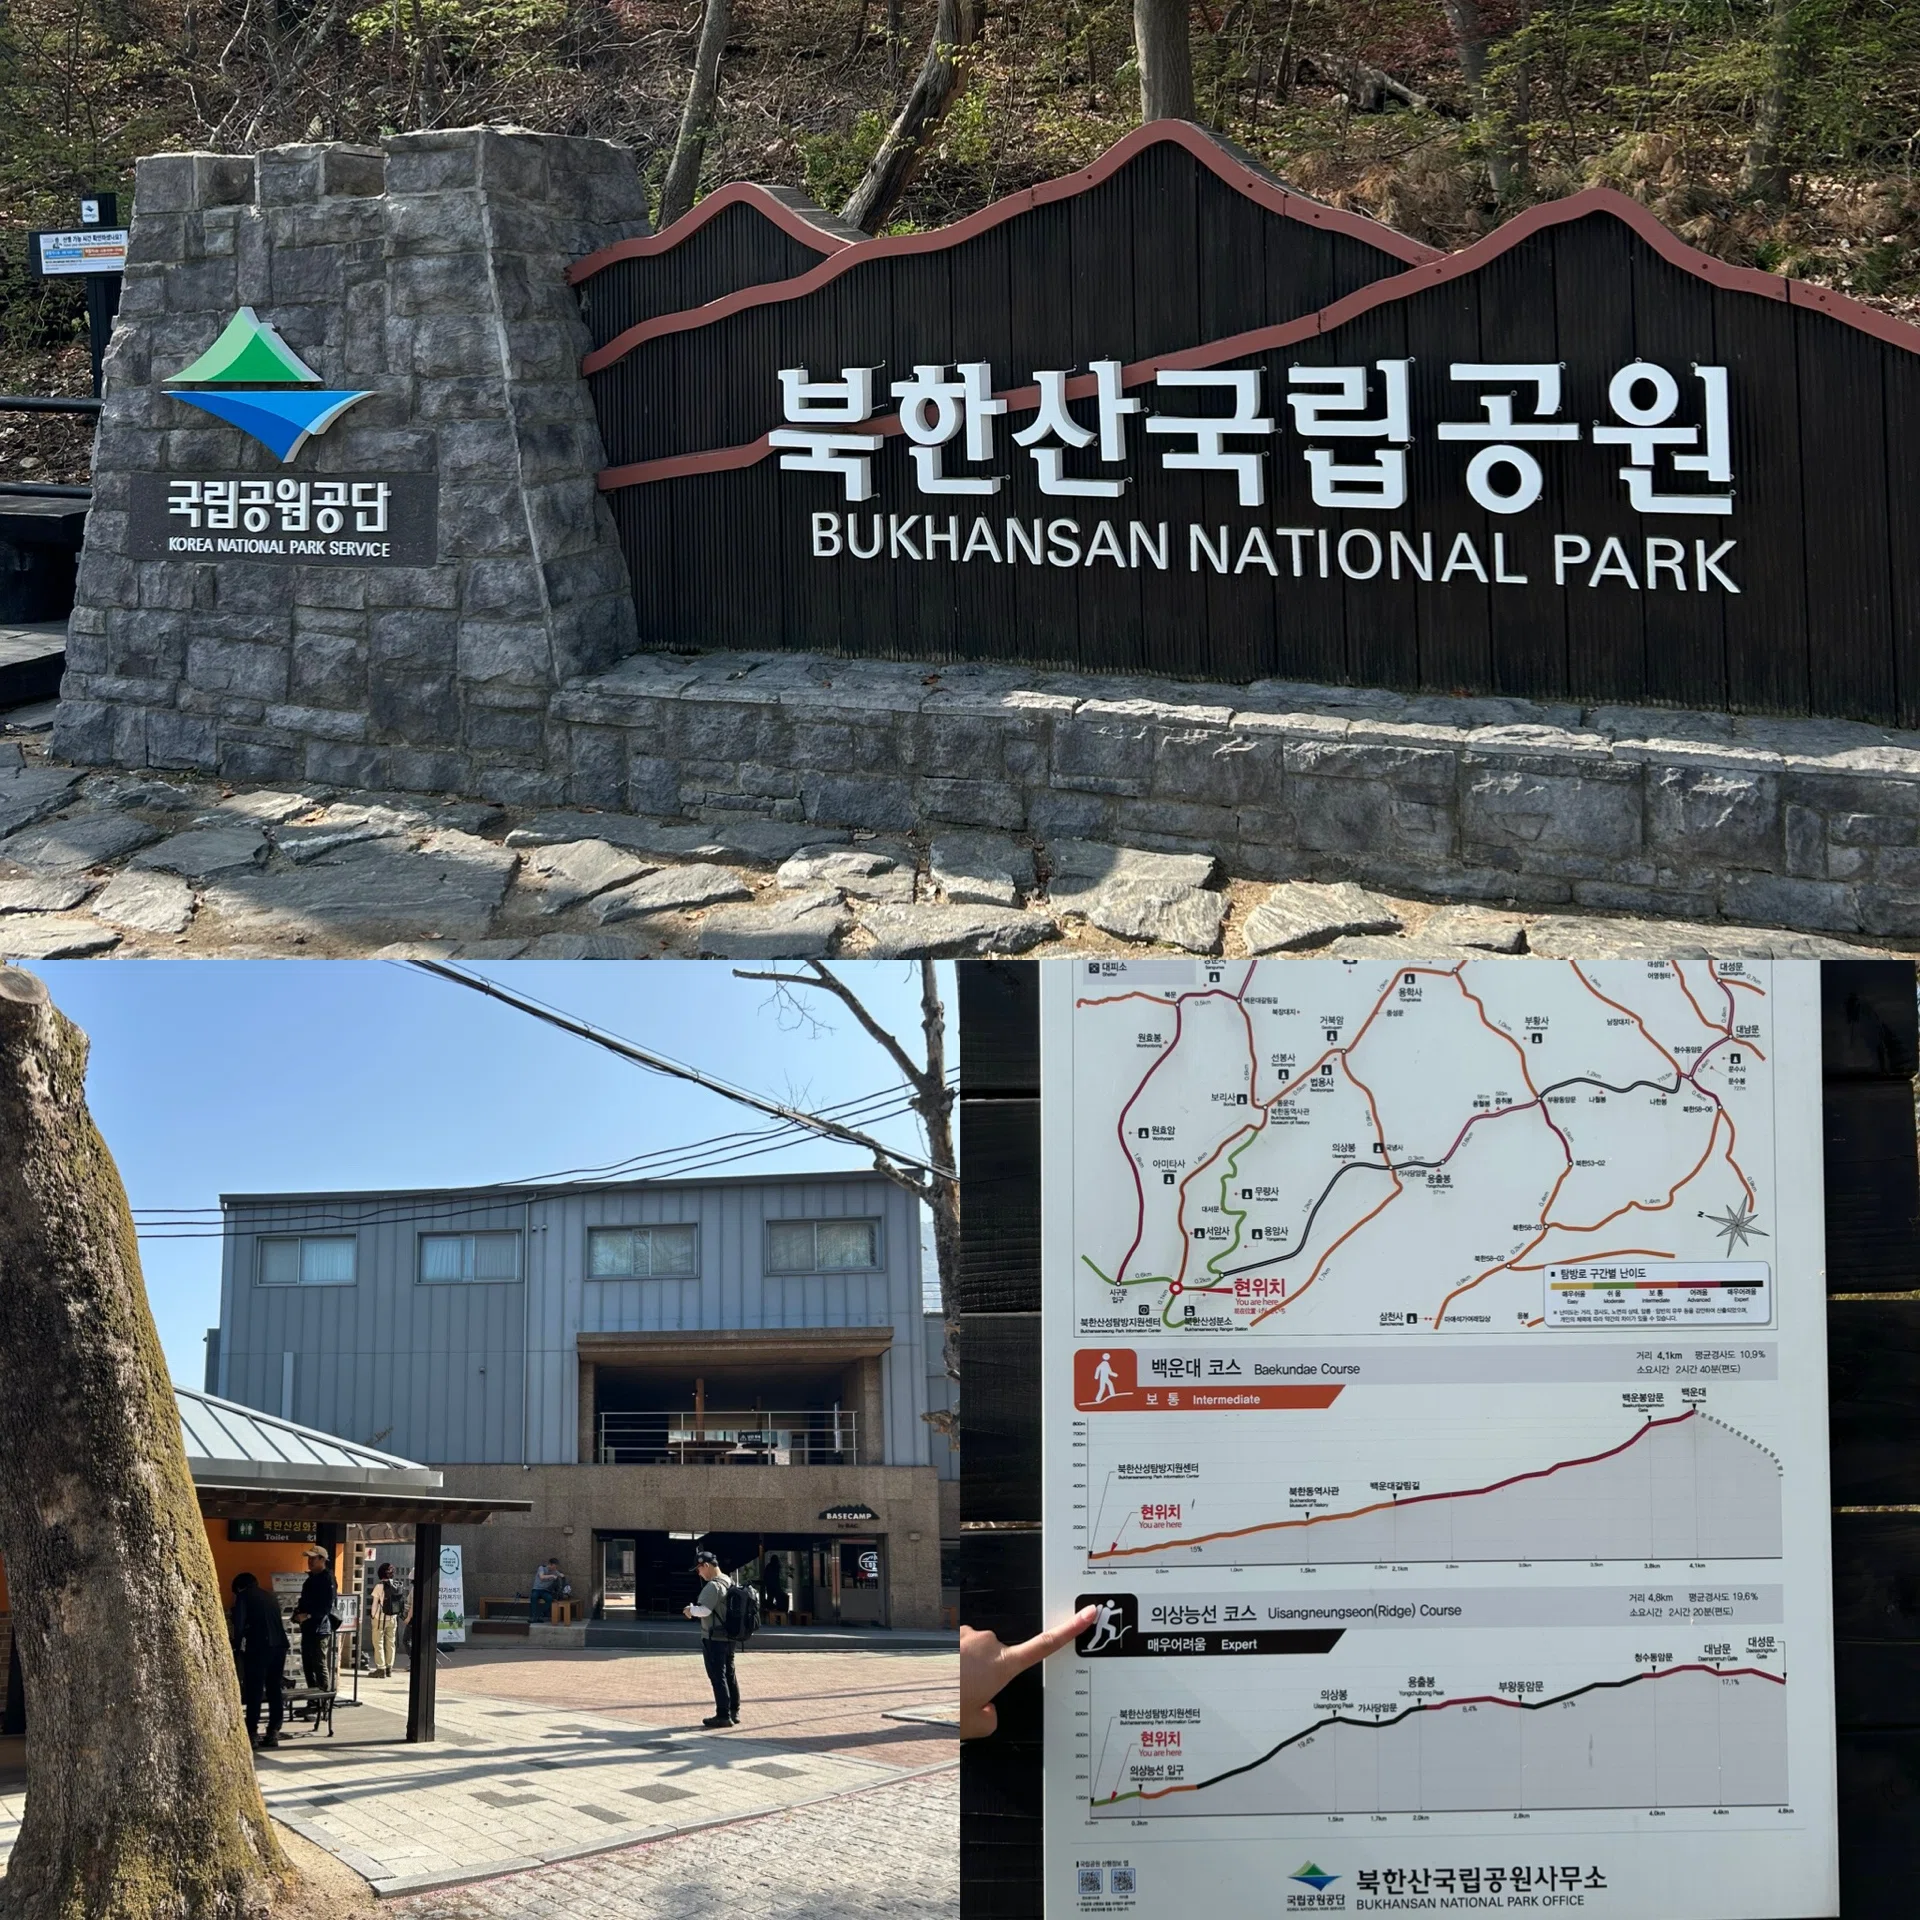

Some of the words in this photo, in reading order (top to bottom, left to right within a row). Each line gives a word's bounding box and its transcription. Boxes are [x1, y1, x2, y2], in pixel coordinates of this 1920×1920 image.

[768, 358, 1733, 516] 북한산국립공원
[168, 478, 391, 533] 국립공원공단
[169, 537, 214, 552] KOREA
[217, 538, 286, 555] NATIONAL
[290, 540, 326, 556] PARK
[330, 541, 391, 558] SERVICE
[811, 511, 1168, 571] BUKHANSAN
[1190, 523, 1528, 585] NATIONAL
[1554, 533, 1741, 594] PARK
[1102, 962, 1127, 971] 대피소
[1720, 963, 1743, 971] 대성문
[1399, 988, 1422, 997] 용학사
[1320, 1016, 1344, 1025] 거북암
[1736, 1025, 1759, 1034] 대남문
[1138, 1033, 1161, 1043] 원효봉
[1271, 1053, 1295, 1063] 선봉사
[1310, 1078, 1334, 1088] 법용사
[1211, 1093, 1235, 1102] 보리사
[1151, 1126, 1175, 1136] 원효암
[1332, 1143, 1356, 1152] 의상봉
[1153, 1159, 1185, 1168] 아미타사
[1255, 1187, 1279, 1197] 무량사
[1206, 1227, 1230, 1236] 서암사
[1264, 1227, 1288, 1236] 용암사
[1560, 1268, 1586, 1279] 탐방로
[1590, 1268, 1617, 1279] 구간별
[1620, 1268, 1646, 1278] 난이도
[1234, 1279, 1285, 1297] 현위치
[1112, 1296, 1124, 1304] 입구
[1184, 1317, 1232, 1326] 북한산성분소
[1379, 1312, 1403, 1321] 삼천사
[1080, 1317, 1161, 1327] 북한산성탐방지원센터
[1636, 1351, 1653, 1360] 거리
[1657, 1351, 1682, 1360] 4.1km
[1695, 1351, 1736, 1360] 평균경사도
[1740, 1350, 1766, 1359] 10.9%
[1152, 1358, 1201, 1378] 백운대
[1208, 1359, 1242, 1376] 코스
[1254, 1363, 1317, 1375] Baekundae
[1321, 1363, 1360, 1375] Course
[1636, 1365, 1670, 1374] 소요시간
[1675, 1365, 1697, 1374] 2시간
[1700, 1364, 1741, 1374] 40분(편도)
[1681, 1388, 1706, 1397] 백운대
[1193, 1394, 1260, 1405] Intermediate
[1622, 1393, 1664, 1403] 백운봉암문
[1118, 1463, 1199, 1473] 북한산성탐방지원센터
[1369, 1481, 1420, 1491] 백운대갈림길
[1289, 1487, 1339, 1496] 북한동역사관
[1140, 1504, 1181, 1520] 현위치
[1139, 1521, 1154, 1529] You
[1166, 1521, 1182, 1529] here
[1629, 1594, 1645, 1602] 거리
[1648, 1593, 1673, 1602] 4.8km
[1689, 1592, 1730, 1601] 평균경사도
[1733, 1592, 1758, 1601] 19.6%
[1152, 1605, 1217, 1624] 의상능선
[1223, 1605, 1257, 1621] 코스
[1268, 1603, 1416, 1620] Uisangneungseon(Ridge)
[1420, 1603, 1462, 1616] Course
[1629, 1608, 1662, 1617] 소요시간
[1669, 1608, 1691, 1617] 2시간
[1693, 1607, 1734, 1616] 20분(편도)
[1148, 1638, 1206, 1651] 매우어려움
[1221, 1638, 1257, 1650] Expert
[1748, 1637, 1775, 1646] 대성문
[1704, 1644, 1732, 1655] 대남문
[1634, 1653, 1673, 1662] 청수동암문
[1407, 1676, 1435, 1687] 용출봉
[1498, 1681, 1544, 1692] 부왕동암문
[1321, 1689, 1348, 1700] 의상봉
[1358, 1703, 1398, 1713] 가사당암문
[1563, 1701, 1575, 1709] 31%
[1120, 1708, 1200, 1718] 북한산성탐방지원센터
[1140, 1731, 1181, 1747] 현위치
[1297, 1736, 1315, 1749] 19.4%
[1139, 1749, 1152, 1757] You
[1130, 1765, 1164, 1776] 의상능선
[1167, 1765, 1184, 1775] 입구
[1356, 1865, 1607, 1895] 북한산국립공원사무소
[1287, 1894, 1345, 1907] 국립공원공단
[1356, 1898, 1436, 1911] BUKHANSAN
[1440, 1896, 1504, 1909] NATIONAL
[1507, 1896, 1538, 1907] PARK
[1542, 1895, 1584, 1907] OFFICE
